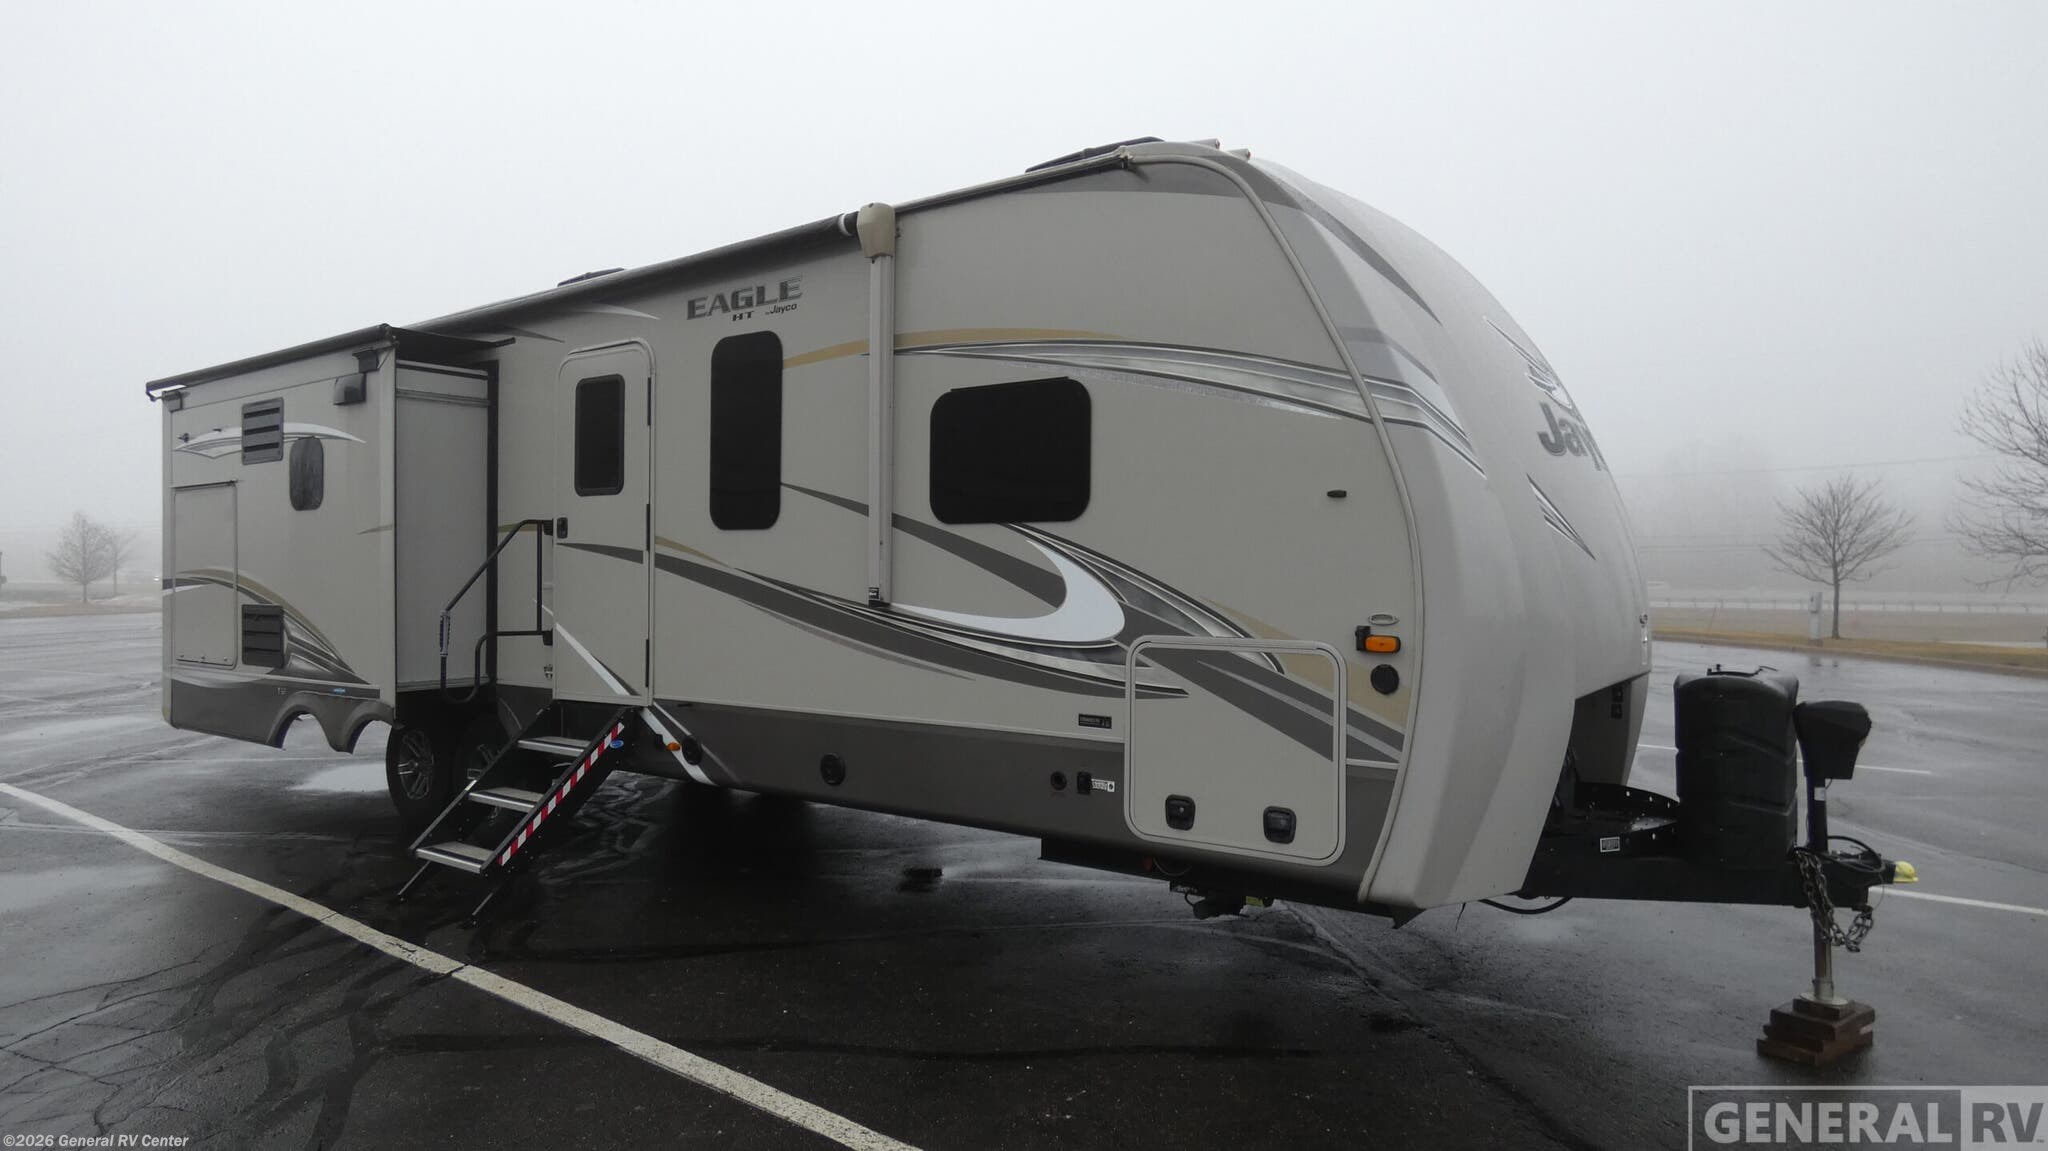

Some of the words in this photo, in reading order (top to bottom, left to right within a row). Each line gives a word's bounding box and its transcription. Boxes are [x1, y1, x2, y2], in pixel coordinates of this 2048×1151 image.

[687, 275, 803, 320] EAGLE
[769, 303, 797, 315] Jayco
[731, 310, 754, 321] HT
